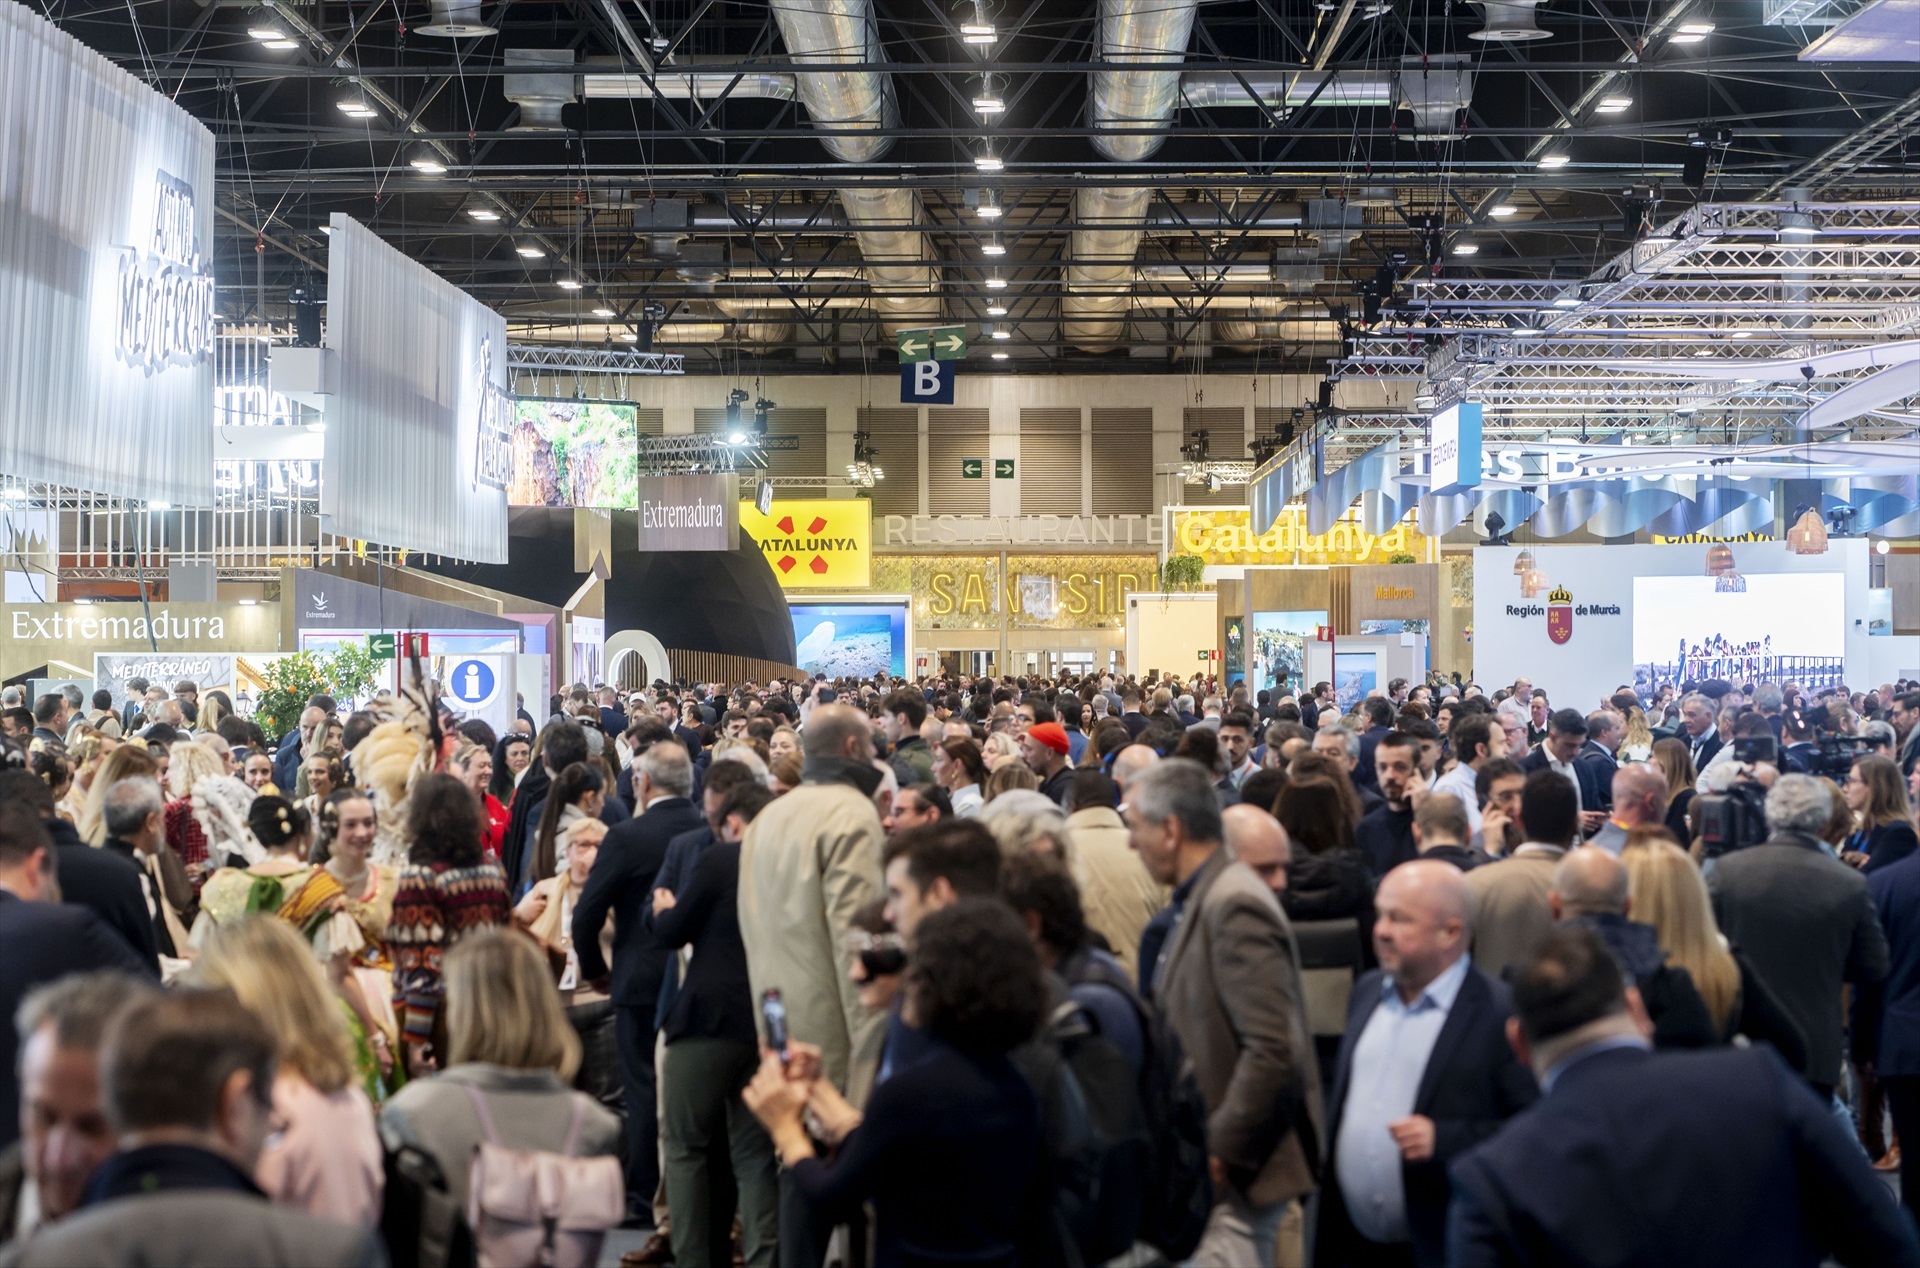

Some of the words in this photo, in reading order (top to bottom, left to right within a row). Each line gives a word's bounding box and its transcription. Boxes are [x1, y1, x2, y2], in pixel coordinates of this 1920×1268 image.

[914, 360, 941, 396] B
[643, 497, 723, 529] Extremadura
[884, 514, 1163, 545] RESTAURANTE
[1180, 514, 1406, 561] Catalunya
[753, 537, 858, 552] ATALUNYA
[931, 573, 1020, 615] SAN
[1375, 585, 1414, 599] Mallorca
[12, 610, 224, 639] Extremadura
[305, 611, 336, 619] Extremadura
[1506, 604, 1545, 618] Región
[1575, 604, 1588, 616] de
[1589, 604, 1621, 616] Murcia
[112, 658, 212, 680] MEDITERRÁNEO
